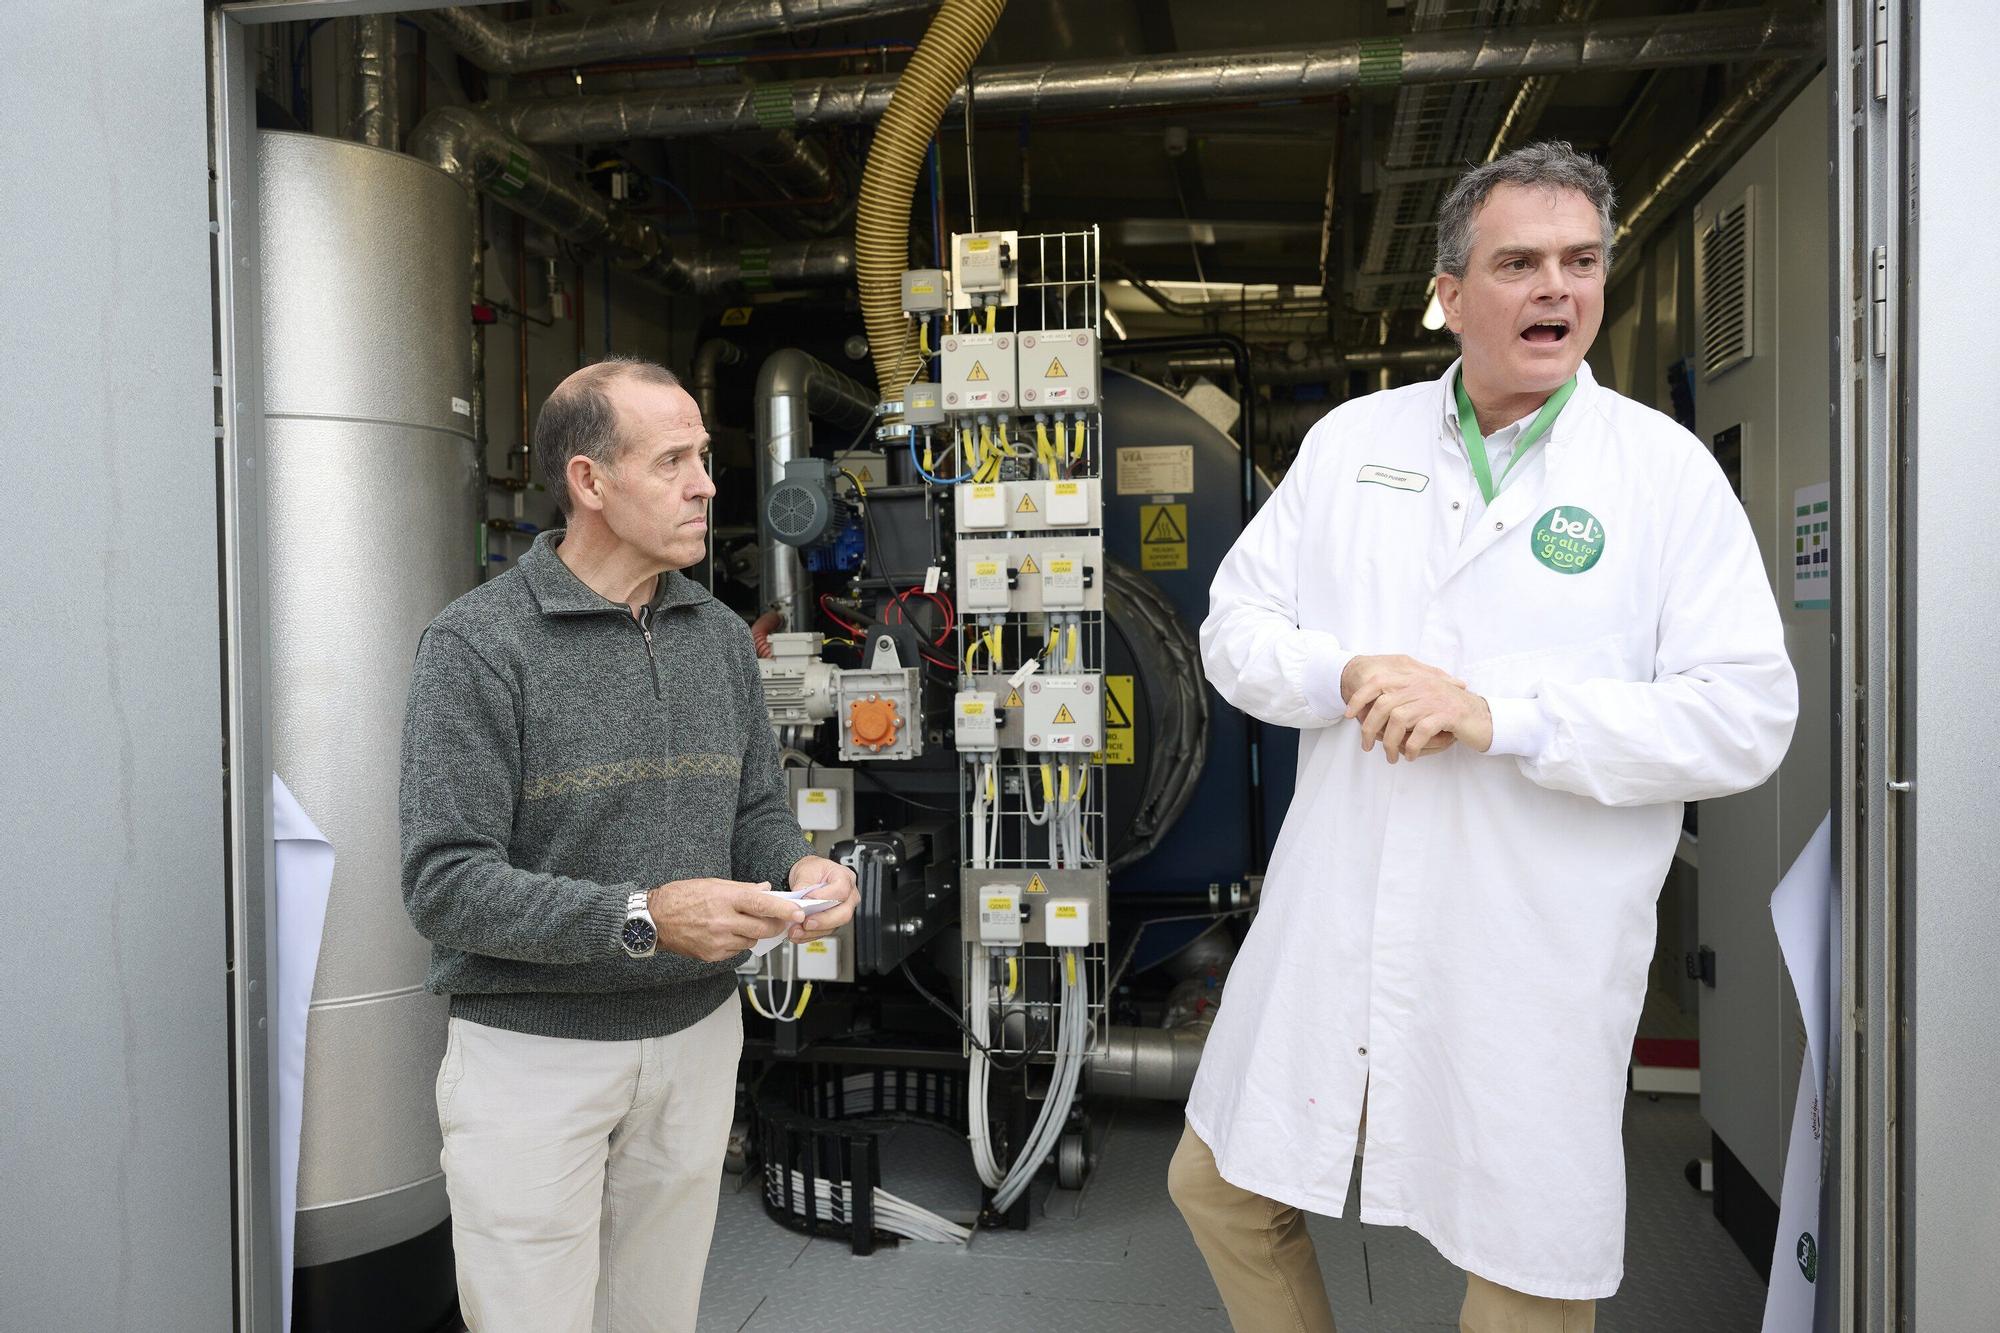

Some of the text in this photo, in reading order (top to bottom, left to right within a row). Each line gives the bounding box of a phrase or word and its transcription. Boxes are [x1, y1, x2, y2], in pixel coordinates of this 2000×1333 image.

[1549, 509, 1594, 543] bel
[1536, 529, 1597, 555] for all for
[1541, 544, 1588, 567] good
[1799, 1238, 1810, 1268] bel
